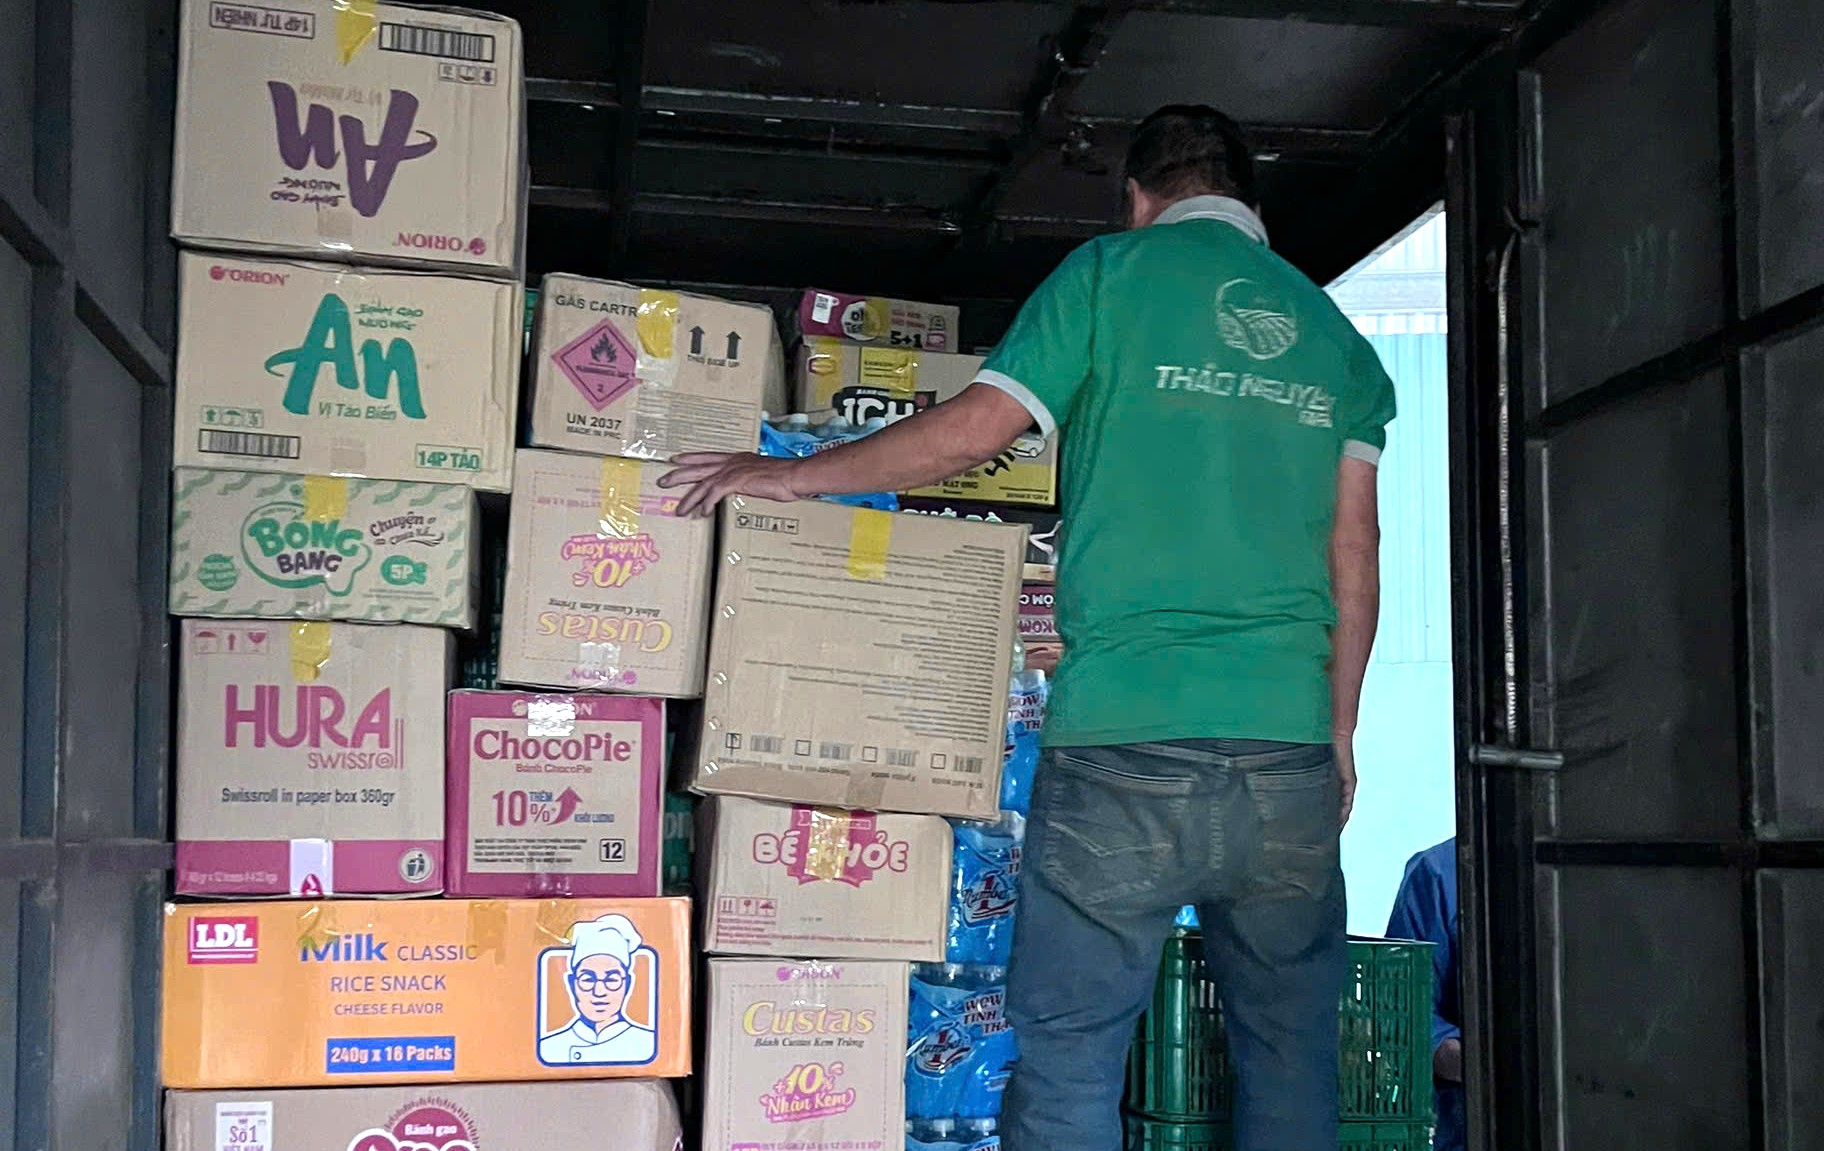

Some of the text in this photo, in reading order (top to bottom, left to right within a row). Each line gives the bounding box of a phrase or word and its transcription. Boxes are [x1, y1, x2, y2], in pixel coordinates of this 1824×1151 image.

[268, 80, 437, 217] An
[396, 231, 464, 252] ORION
[228, 269, 286, 287] ORION
[555, 294, 639, 318] GAS CARTR
[265, 293, 427, 420] An
[567, 412, 622, 431] UN 2037
[418, 450, 447, 468] 14P
[277, 551, 343, 575] BANG
[536, 611, 673, 654] Custas
[225, 684, 391, 748] HURA
[473, 729, 632, 762] ChocoPie
[221, 787, 395, 806] Swissroll in paper box 360gr
[602, 842, 622, 859] 12
[196, 924, 254, 948] LDL
[300, 932, 478, 962] Milk CLASSIC
[330, 974, 447, 992] RICE SNACK
[334, 1002, 444, 1016] CHEESE FLAVOR
[742, 1000, 876, 1036] Custas
[330, 1048, 368, 1065] 240g
[371, 1050, 381, 1063] x
[406, 1044, 452, 1061] Packs
[814, 1091, 850, 1109] Kem
